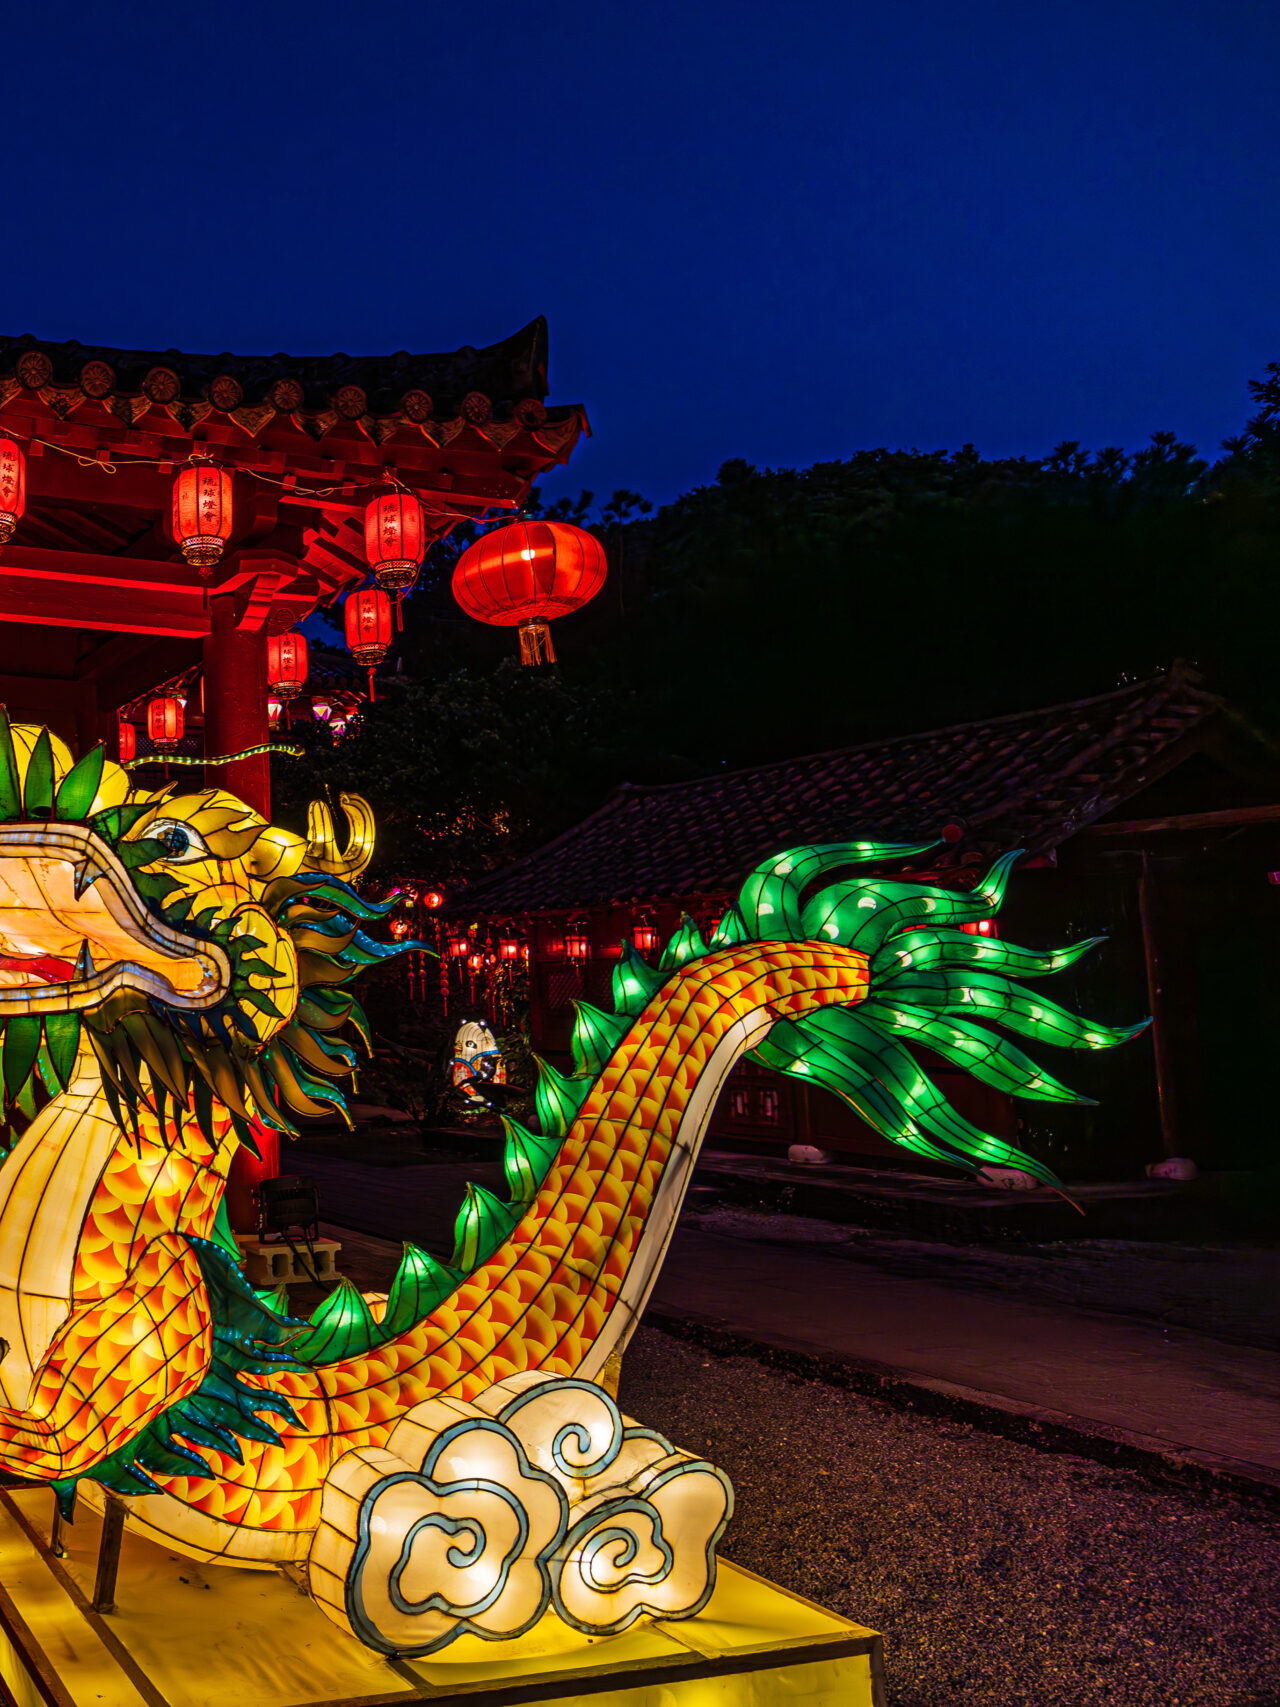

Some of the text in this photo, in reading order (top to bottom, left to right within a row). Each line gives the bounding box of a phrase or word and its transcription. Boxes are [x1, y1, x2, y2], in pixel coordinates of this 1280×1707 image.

[2, 450, 15, 498] 琉球燈會
[202, 476, 217, 523] 琉球燈會
[383, 503, 398, 547] 琉球燈會
